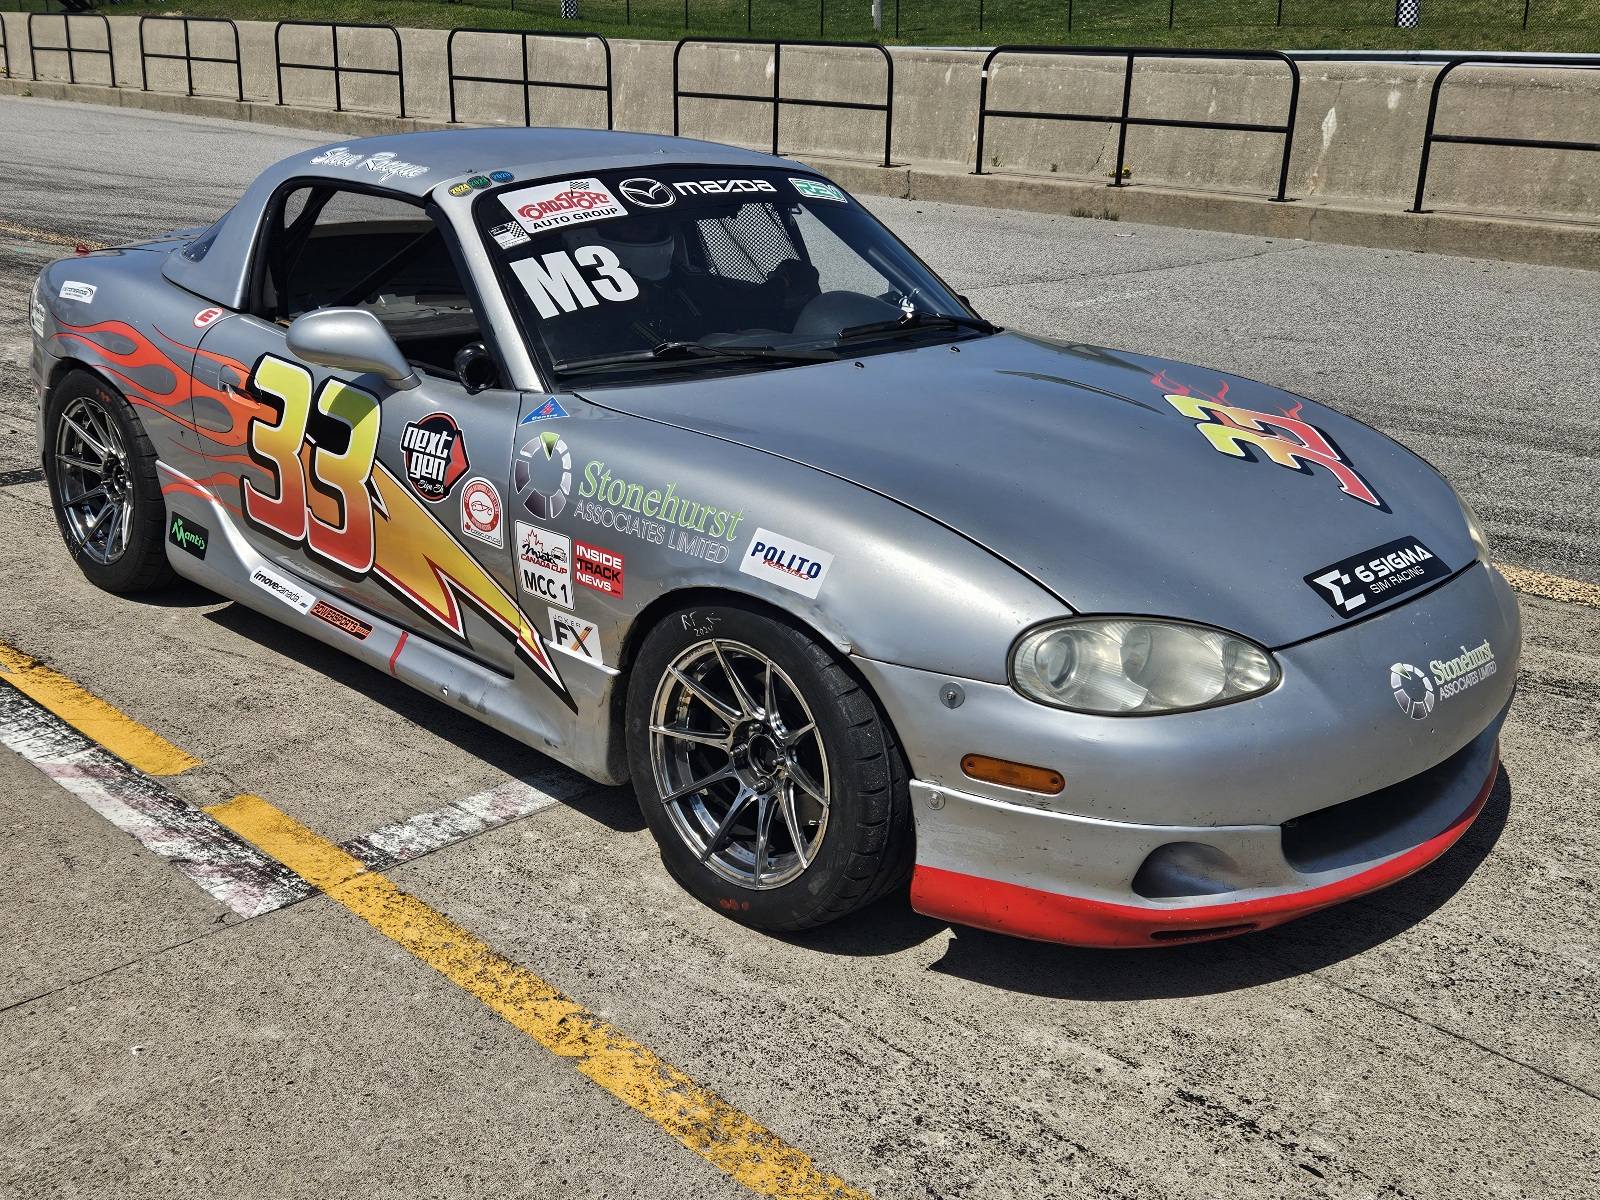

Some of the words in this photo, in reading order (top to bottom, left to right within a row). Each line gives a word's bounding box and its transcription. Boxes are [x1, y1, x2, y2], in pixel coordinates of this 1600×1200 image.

[533, 215, 571, 230] AUTO
[573, 207, 618, 221] GROUP
[509, 245, 639, 320] M3
[403, 426, 453, 458] next
[241, 352, 382, 580] 33
[409, 451, 446, 481] gen
[578, 460, 744, 542] Stonehurst
[171, 518, 206, 549] Mantis
[573, 500, 666, 545] ASSOCIATES
[668, 528, 730, 564] LIMITED
[520, 554, 550, 570] CANADA
[551, 565, 568, 575] CUP
[576, 545, 622, 570] INSIDE
[577, 558, 620, 584] TRACK
[750, 541, 822, 579] POLITO
[1354, 565, 1372, 583] 6
[1369, 544, 1434, 578] SIGMA
[523, 569, 557, 600] MCC
[560, 584, 568, 604] 1
[576, 571, 612, 592] NEWS
[1369, 576, 1391, 595] SIM
[1390, 565, 1425, 587] RACING
[312, 603, 359, 632] POWERSPORTS
[553, 614, 581, 628] JOKER
[554, 620, 594, 658] FX
[1429, 639, 1496, 686] Stonehurst
[1440, 673, 1479, 701] ASSOCIATES
[1478, 660, 1497, 682] LIMITED
